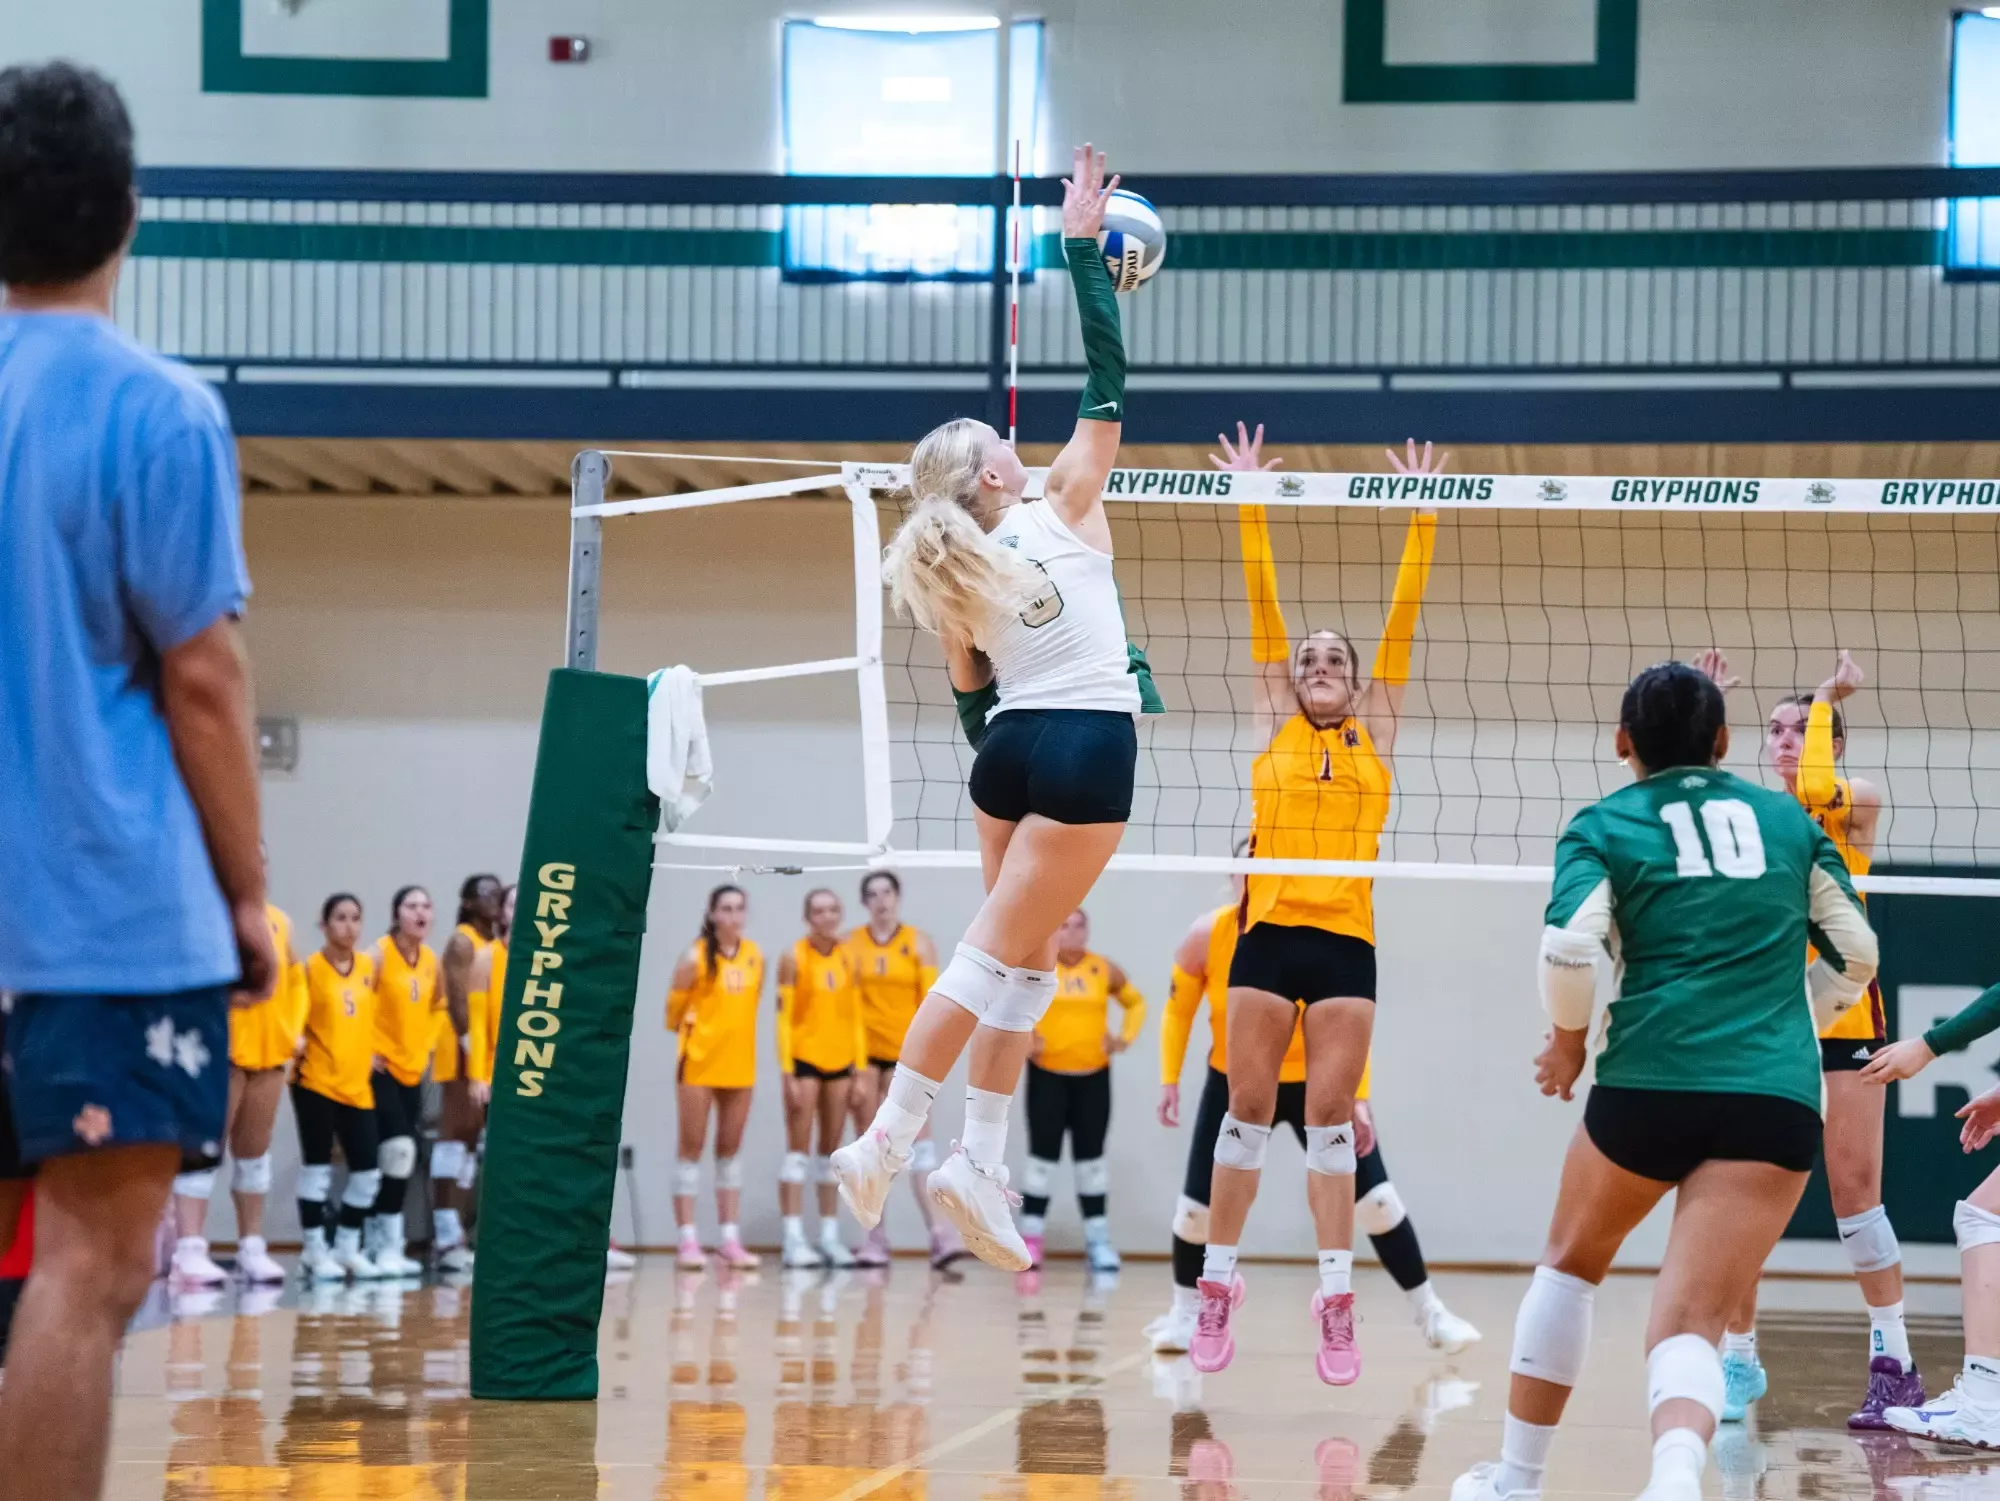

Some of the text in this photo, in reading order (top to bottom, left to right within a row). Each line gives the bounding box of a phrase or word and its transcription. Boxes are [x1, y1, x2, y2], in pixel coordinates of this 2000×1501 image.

[1101, 471, 1233, 496] RYPHONS
[1348, 476, 1494, 500] GRYPHONS
[1611, 479, 1761, 504] GRYPHONS
[1881, 482, 2000, 505] GRYPHO
[1659, 798, 1767, 880] 10
[514, 862, 576, 1097] GRYPHONS
